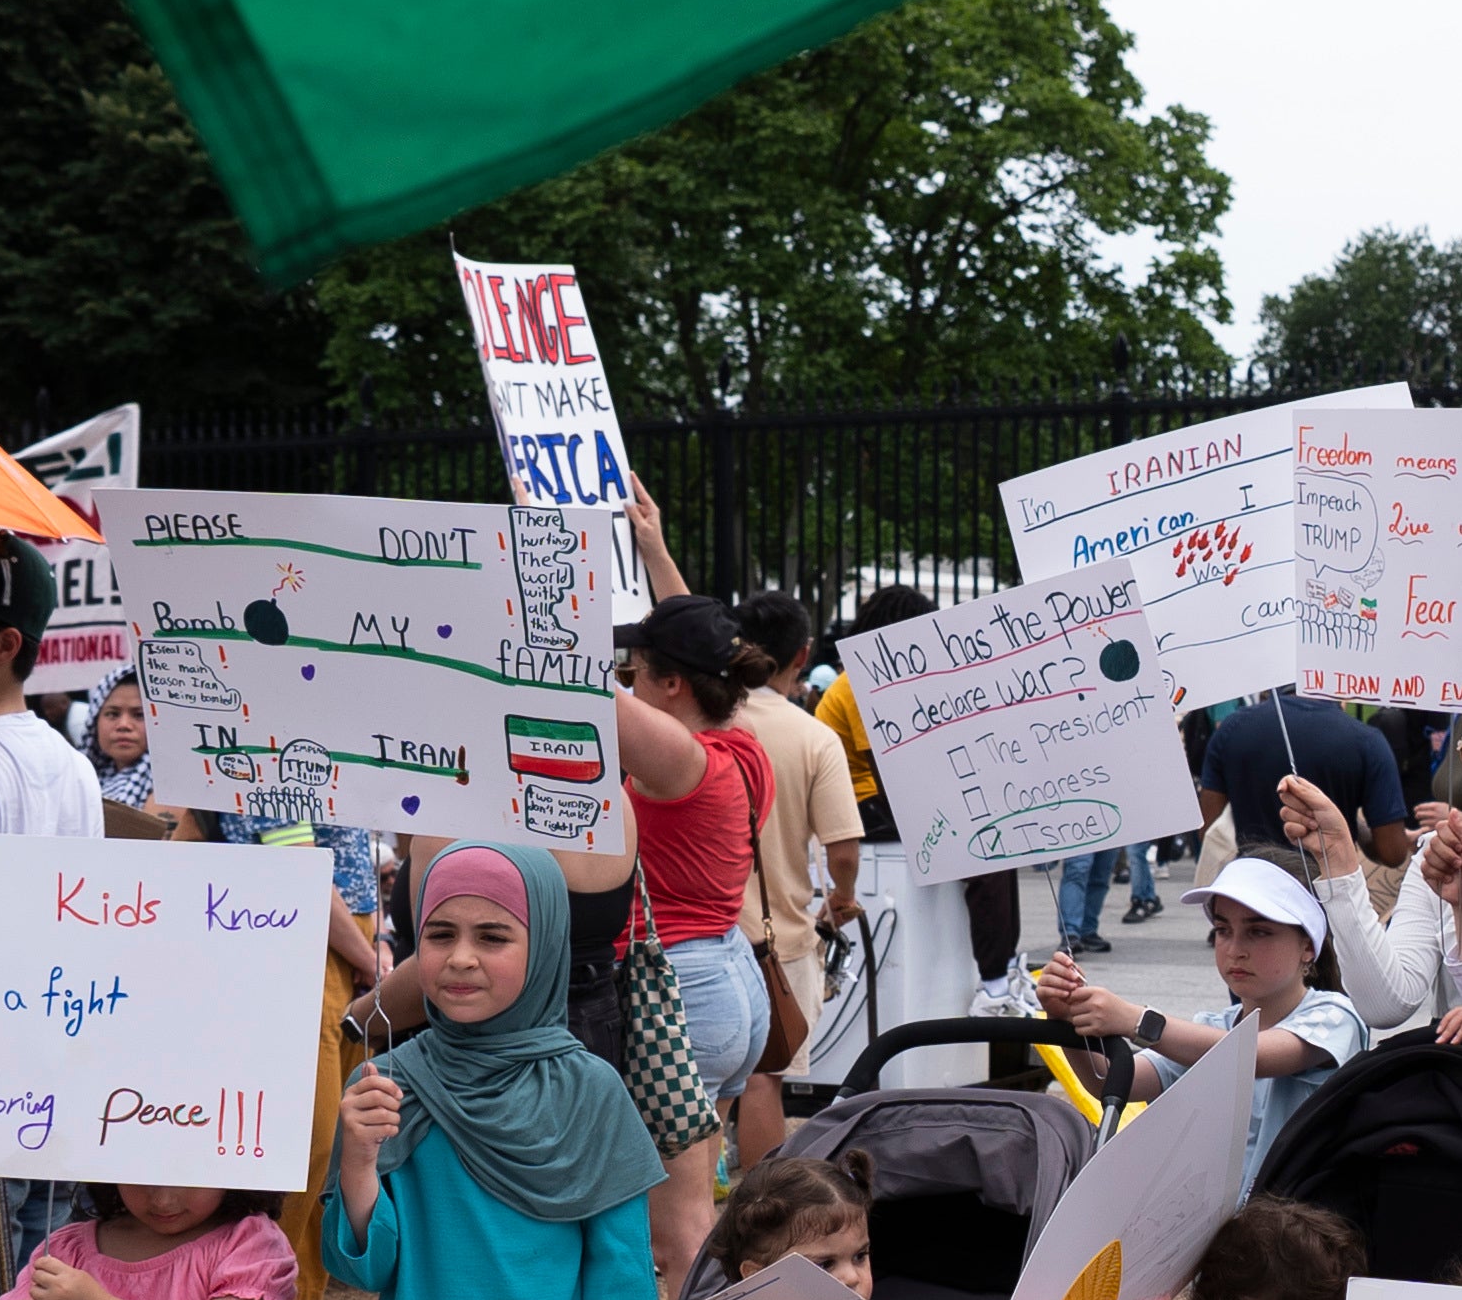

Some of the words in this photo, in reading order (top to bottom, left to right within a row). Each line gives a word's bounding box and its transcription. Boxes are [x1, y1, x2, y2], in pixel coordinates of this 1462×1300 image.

[535, 377, 611, 419] MAKE
[1298, 426, 1372, 466] Freedom
[1396, 455, 1457, 475] means
[1017, 497, 1056, 528] I'm
[1106, 433, 1243, 496] IRANIAN
[1239, 484, 1256, 511] I
[1297, 482, 1362, 513] Impeach
[514, 510, 562, 528] There
[379, 526, 476, 565] DON'T
[521, 533, 572, 548] hurting
[1302, 523, 1362, 553] TRUMP
[519, 551, 553, 568] The
[521, 568, 568, 584] world
[524, 587, 559, 601] with
[1405, 575, 1457, 626] Fear
[528, 602, 550, 615] all
[152, 600, 236, 633] Bomb
[349, 612, 411, 651] MY
[531, 617, 557, 632] this
[184, 645, 195, 656] is
[855, 633, 927, 686] Who
[932, 618, 992, 669] has
[989, 604, 1046, 652] the
[146, 657, 169, 671] the
[178, 664, 209, 675] main
[148, 674, 186, 687] reason
[190, 677, 218, 690] Iran
[150, 687, 160, 696] is
[168, 690, 196, 703] being
[1302, 670, 1324, 691] IN
[1333, 674, 1380, 695] IRAN
[1391, 676, 1425, 698] AND
[872, 707, 903, 749] to
[912, 685, 991, 734] declare
[193, 723, 237, 749] IN
[529, 741, 584, 756] IRAN
[975, 732, 1028, 765] The
[1002, 764, 1111, 815] Congress
[557, 799, 596, 813] wrongs
[1012, 802, 1111, 853] Israel
[57, 872, 162, 927] Kids
[205, 883, 298, 931] Know
[4, 990, 27, 1011] a
[42, 966, 129, 1037] fight
